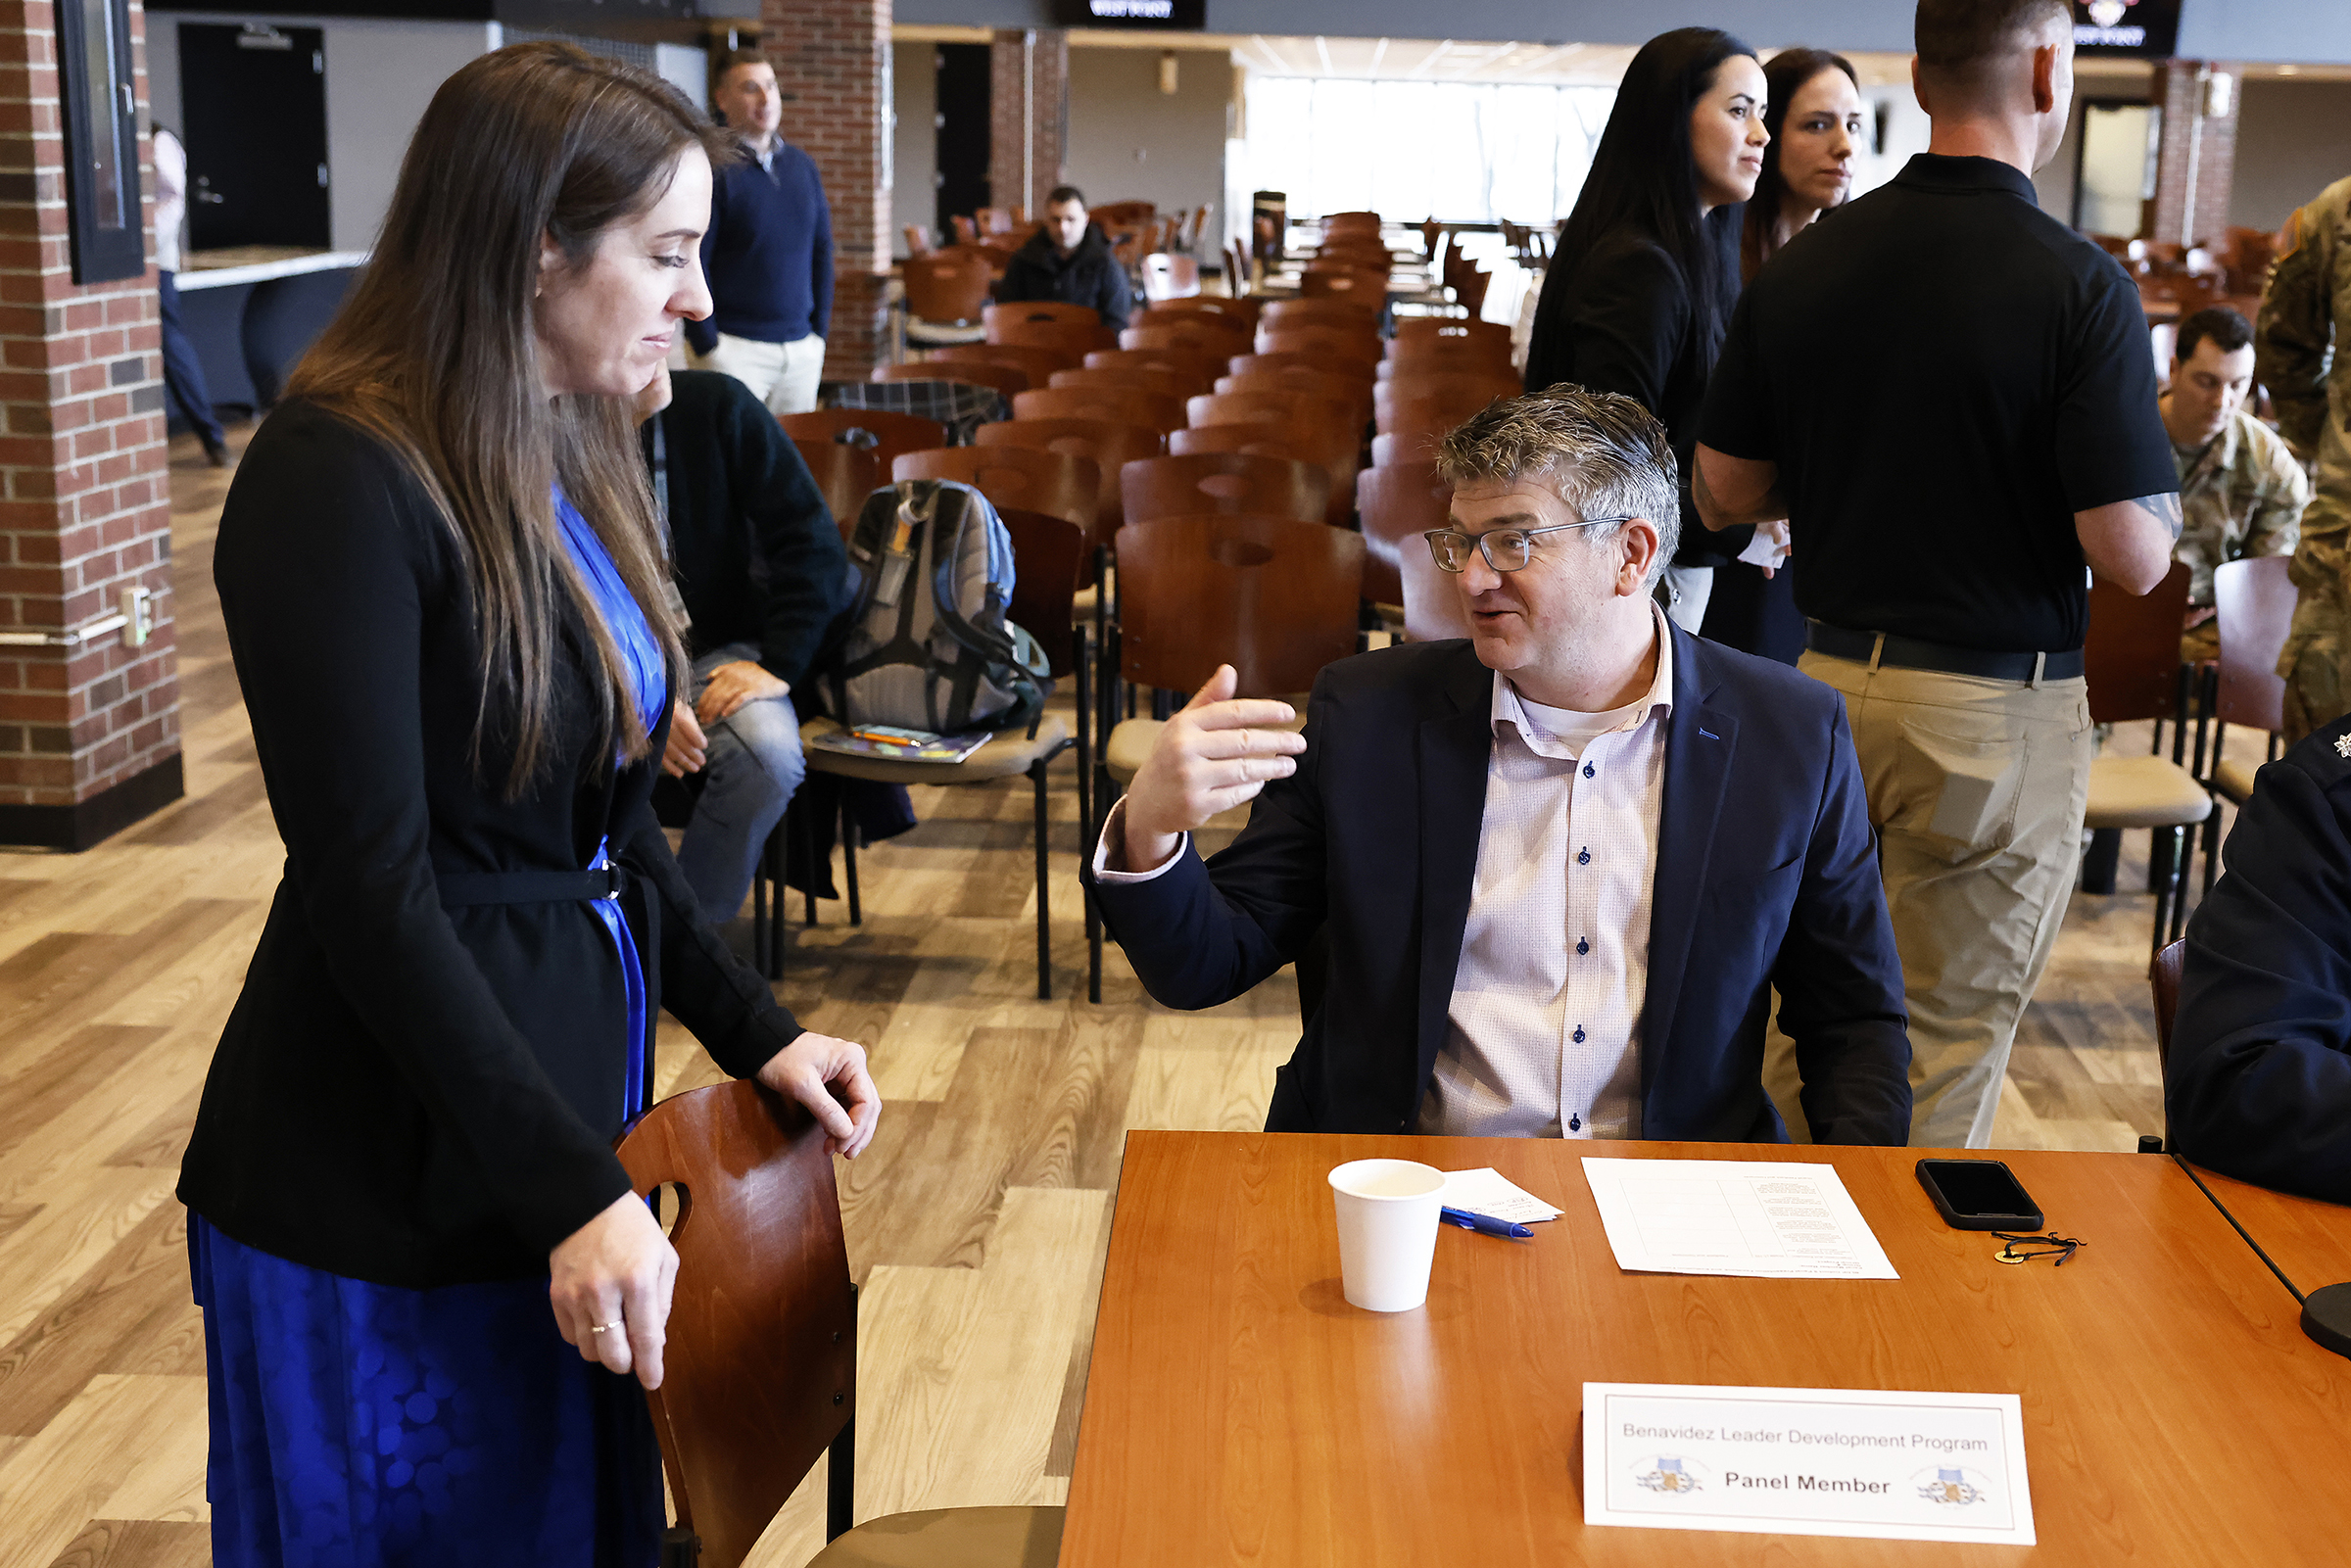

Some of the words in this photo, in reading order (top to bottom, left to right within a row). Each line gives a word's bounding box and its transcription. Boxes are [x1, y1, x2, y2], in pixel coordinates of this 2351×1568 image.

[1622, 1423, 1715, 1442] Benavidez
[1720, 1427, 1782, 1444] Leader
[1788, 1429, 1906, 1449] Development
[1911, 1434, 1989, 1453] Program
[1725, 1471, 1789, 1490] Panel
[1798, 1475, 1892, 1494] Member
